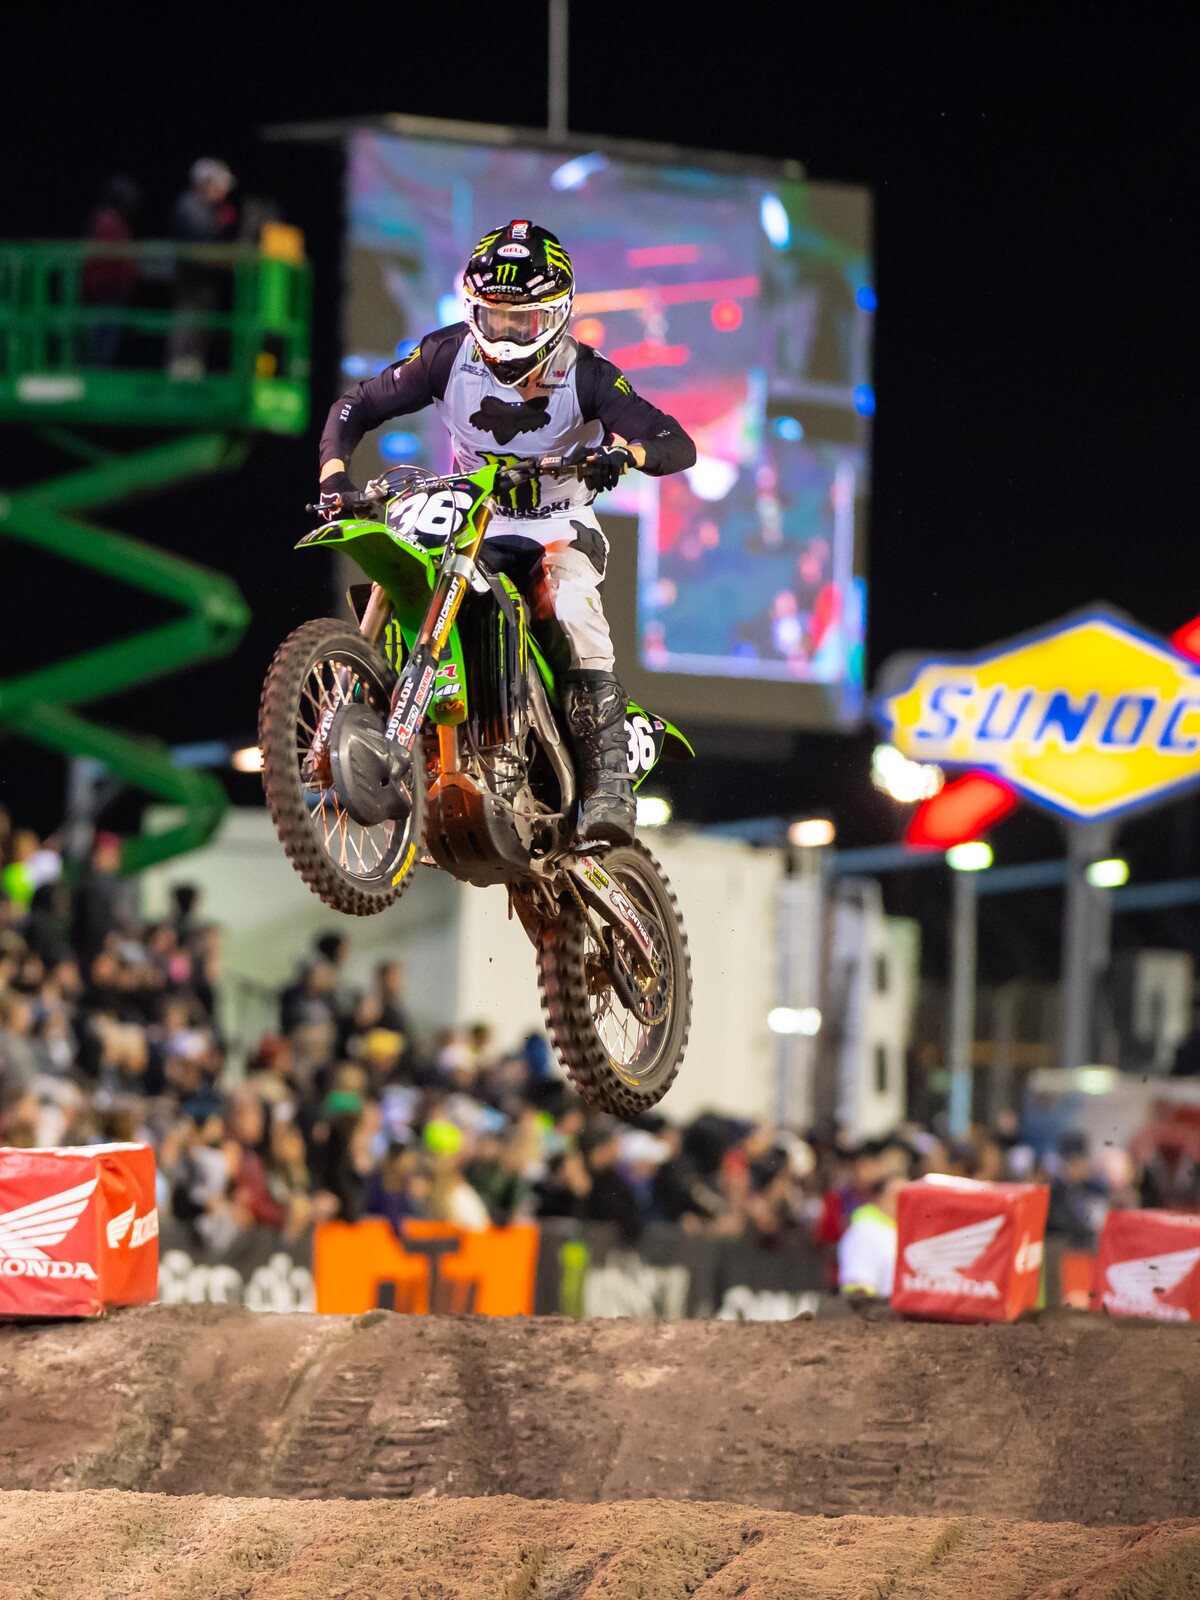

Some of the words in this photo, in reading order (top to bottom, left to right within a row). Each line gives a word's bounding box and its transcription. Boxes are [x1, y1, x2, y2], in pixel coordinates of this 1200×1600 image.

[503, 247, 523, 255] BELL
[340, 404, 352, 421] FOX
[389, 490, 473, 537] 36
[432, 616, 446, 640] PRO
[441, 576, 460, 618] CIRCUIT
[414, 666, 433, 704] BRAKING
[386, 677, 414, 741] DUNLOP
[624, 716, 655, 773] 36
[903, 1274, 999, 1299] HONDA
